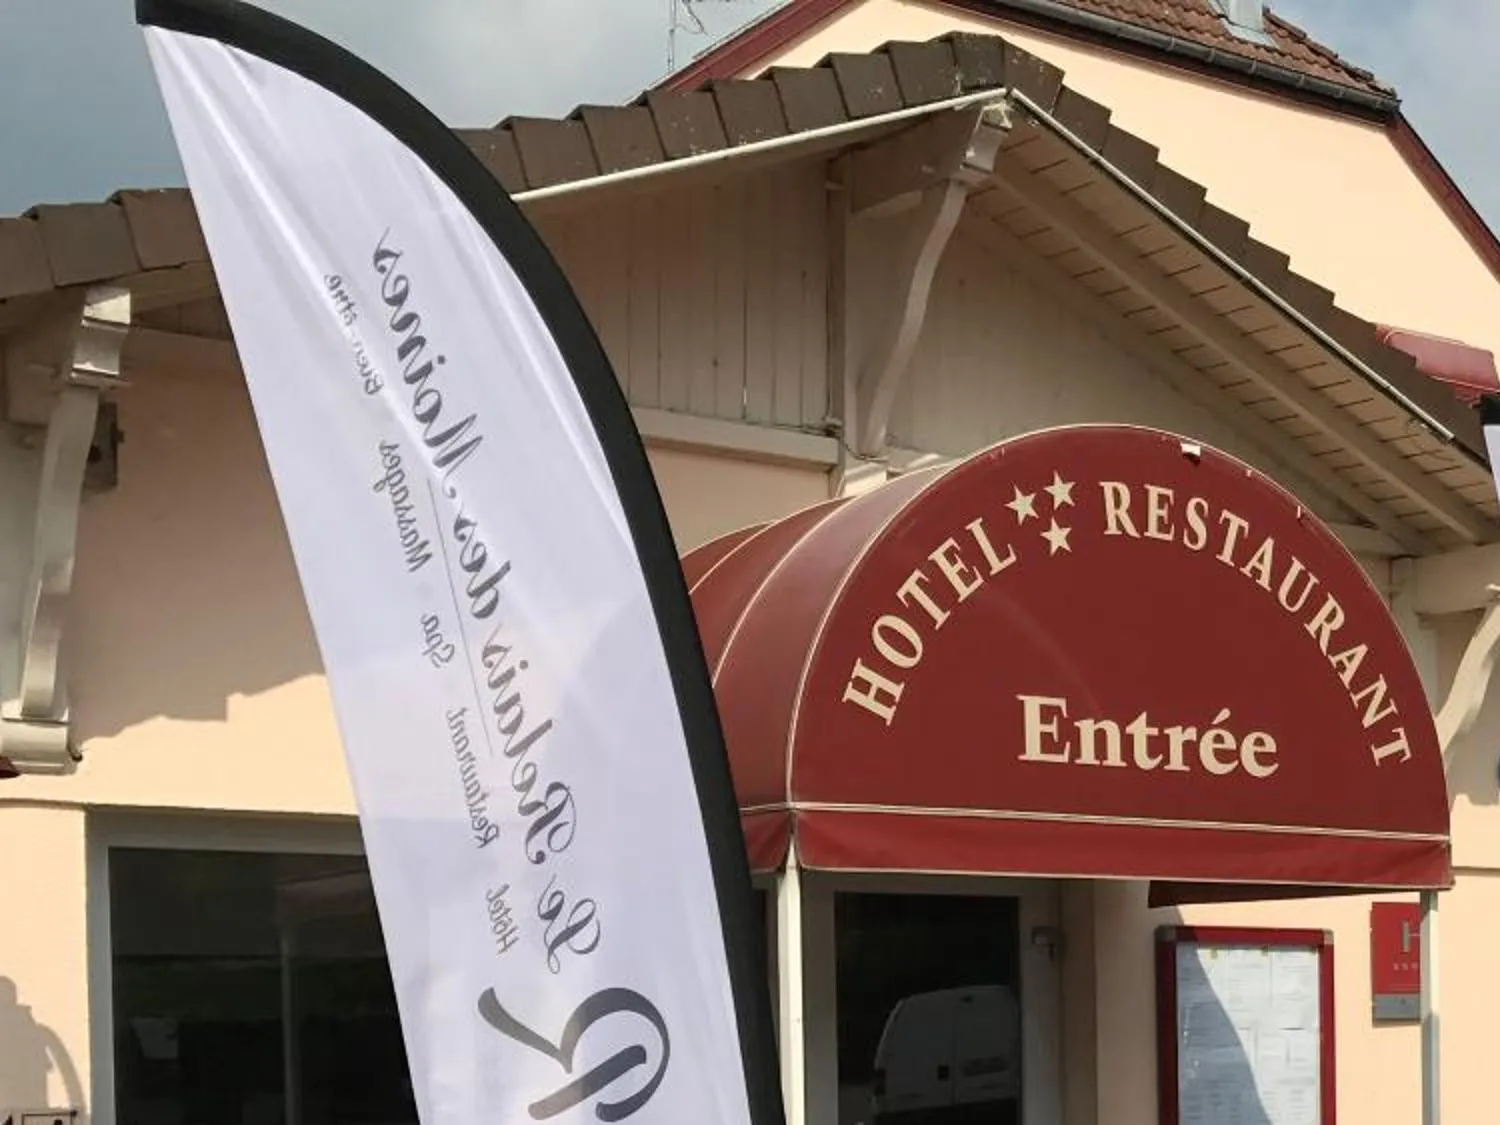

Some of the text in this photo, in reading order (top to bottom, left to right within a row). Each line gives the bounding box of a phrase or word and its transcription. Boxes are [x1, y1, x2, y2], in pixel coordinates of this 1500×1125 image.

[841, 481, 1412, 768] HOTEL RESTAURANT
[1016, 694, 1280, 778] Entrée
